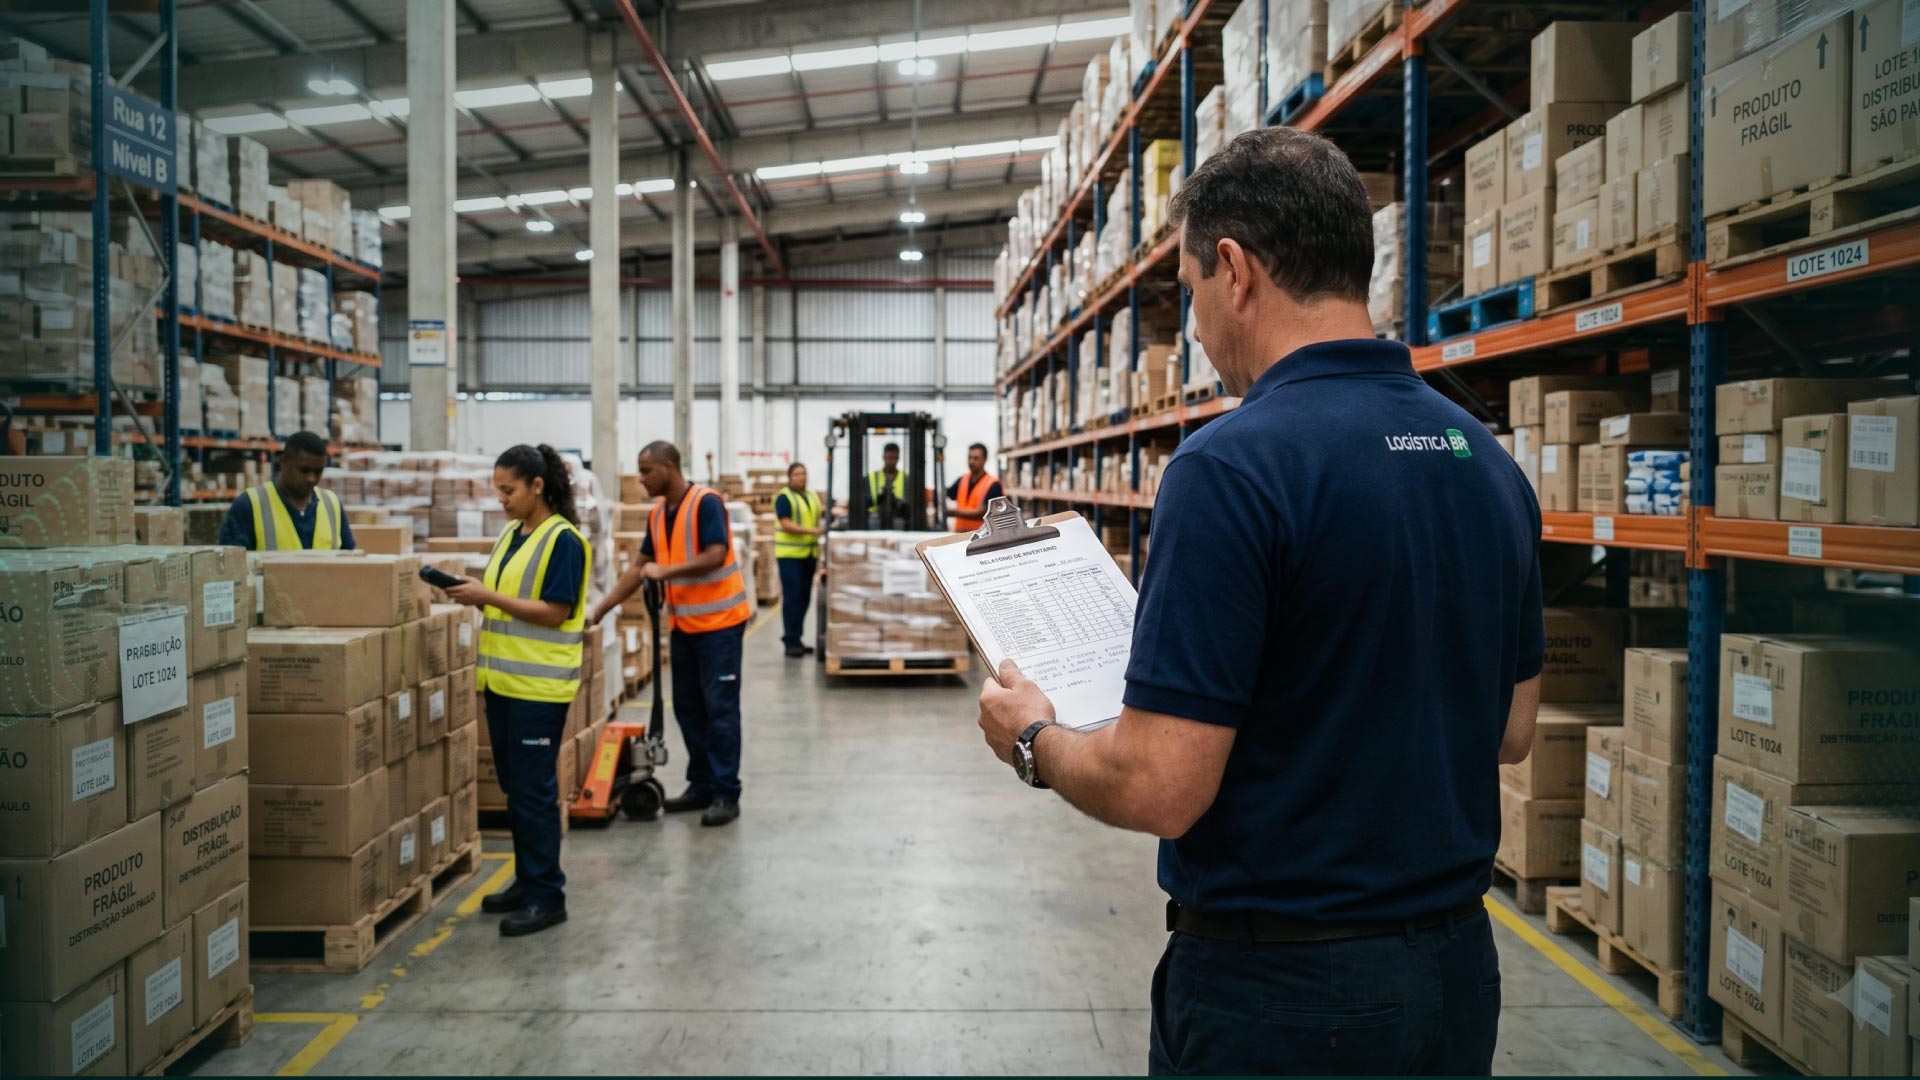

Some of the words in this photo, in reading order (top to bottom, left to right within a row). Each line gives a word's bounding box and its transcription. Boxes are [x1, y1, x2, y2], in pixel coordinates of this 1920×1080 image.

[1875, 51, 1908, 80] LOTE
[113, 95, 144, 132] Rua
[149, 112, 167, 141] 12
[1733, 79, 1801, 124] PRODUTO
[1870, 107, 1897, 132] SÃO
[1901, 99, 1920, 122] PA
[1741, 112, 1792, 147] FRÁGIL
[113, 139, 153, 178] Nível
[156, 156, 168, 184] B
[1792, 254, 1825, 277] LOTE
[1831, 245, 1862, 267] 1024
[1385, 432, 1450, 451] LOGÍSTICA
[1449, 435, 1468, 450] BR
[132, 671, 155, 689] LOTE
[157, 666, 177, 682] 1024
[1731, 727, 1757, 747] LOTE
[1760, 737, 1782, 755] 1024
[77, 779, 95, 795] LOTE
[197, 832, 230, 860] FRÁGIL
[84, 852, 144, 895] PRODUTO
[1724, 853, 1748, 877] LOTE
[1751, 870, 1772, 889] 1024
[93, 880, 137, 917] FRÁGIL
[69, 911, 121, 947] DISTRIBUIÇÃO
[136, 891, 156, 910] PAULO
[1720, 973, 1742, 1000] LOTE
[1744, 991, 1765, 1015] 1024
[77, 1046, 94, 1066] LOTE
